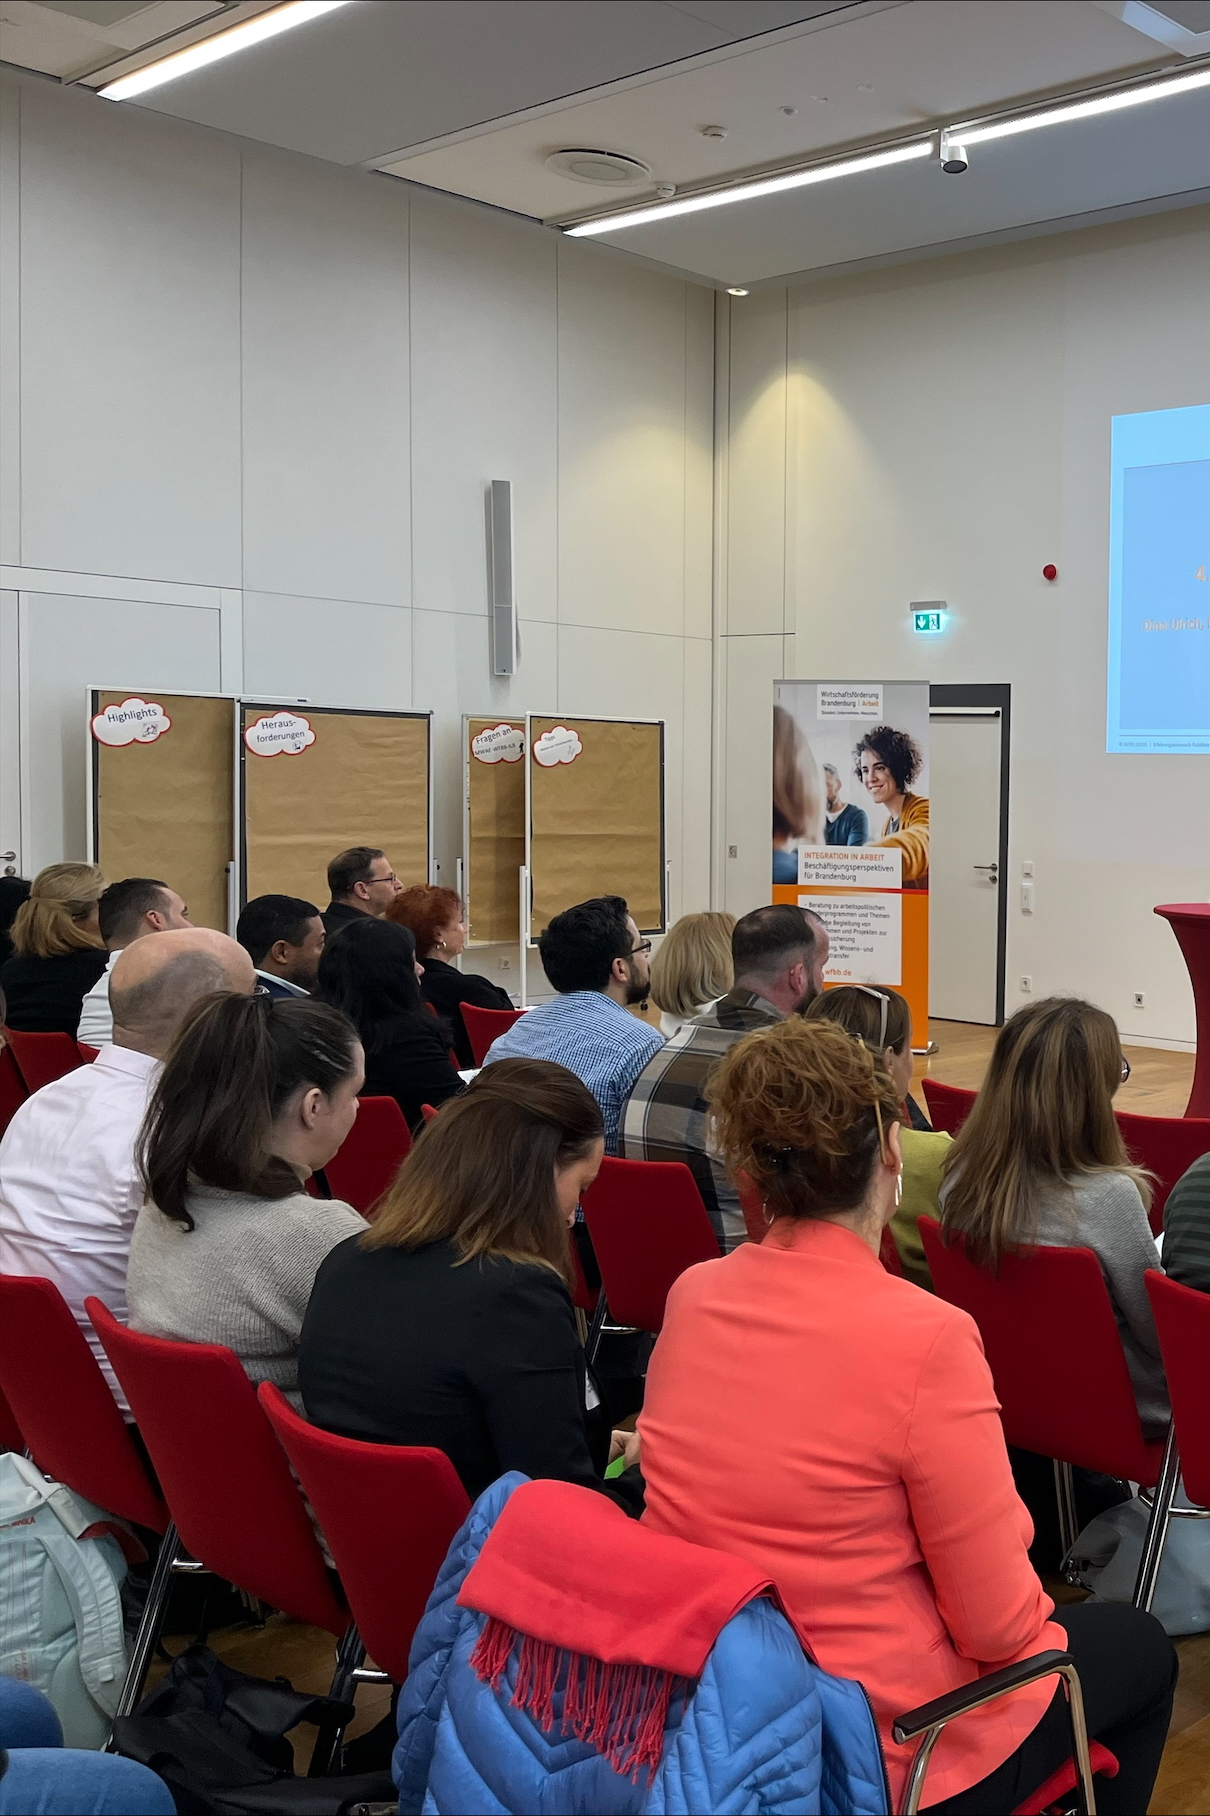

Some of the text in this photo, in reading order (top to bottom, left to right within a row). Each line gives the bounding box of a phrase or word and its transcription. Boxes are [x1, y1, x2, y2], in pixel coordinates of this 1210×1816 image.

[1194, 564, 1210, 582] 4.
[1142, 619, 1167, 632] Dina
[1169, 617, 1204, 632] Ulrich,
[821, 691, 879, 700] Wirtschaftsförderung
[821, 700, 856, 708] Brandenburg
[107, 708, 157, 723] Highlights
[261, 719, 297, 730] Heraus-
[256, 731, 305, 743] forderungen
[475, 728, 512, 745] Fragen an
[804, 852, 849, 860] INTEGRATION
[860, 853, 885, 861] ARBEIT
[804, 861, 894, 872] Beschäftigungsperspektiven
[804, 871, 857, 882] für Brandenburg
[808, 901, 831, 909] Beratung
[840, 903, 885, 911] arbeitspolitischen
[833, 920, 860, 928] Begleitung
[853, 928, 878, 936] Projekten
